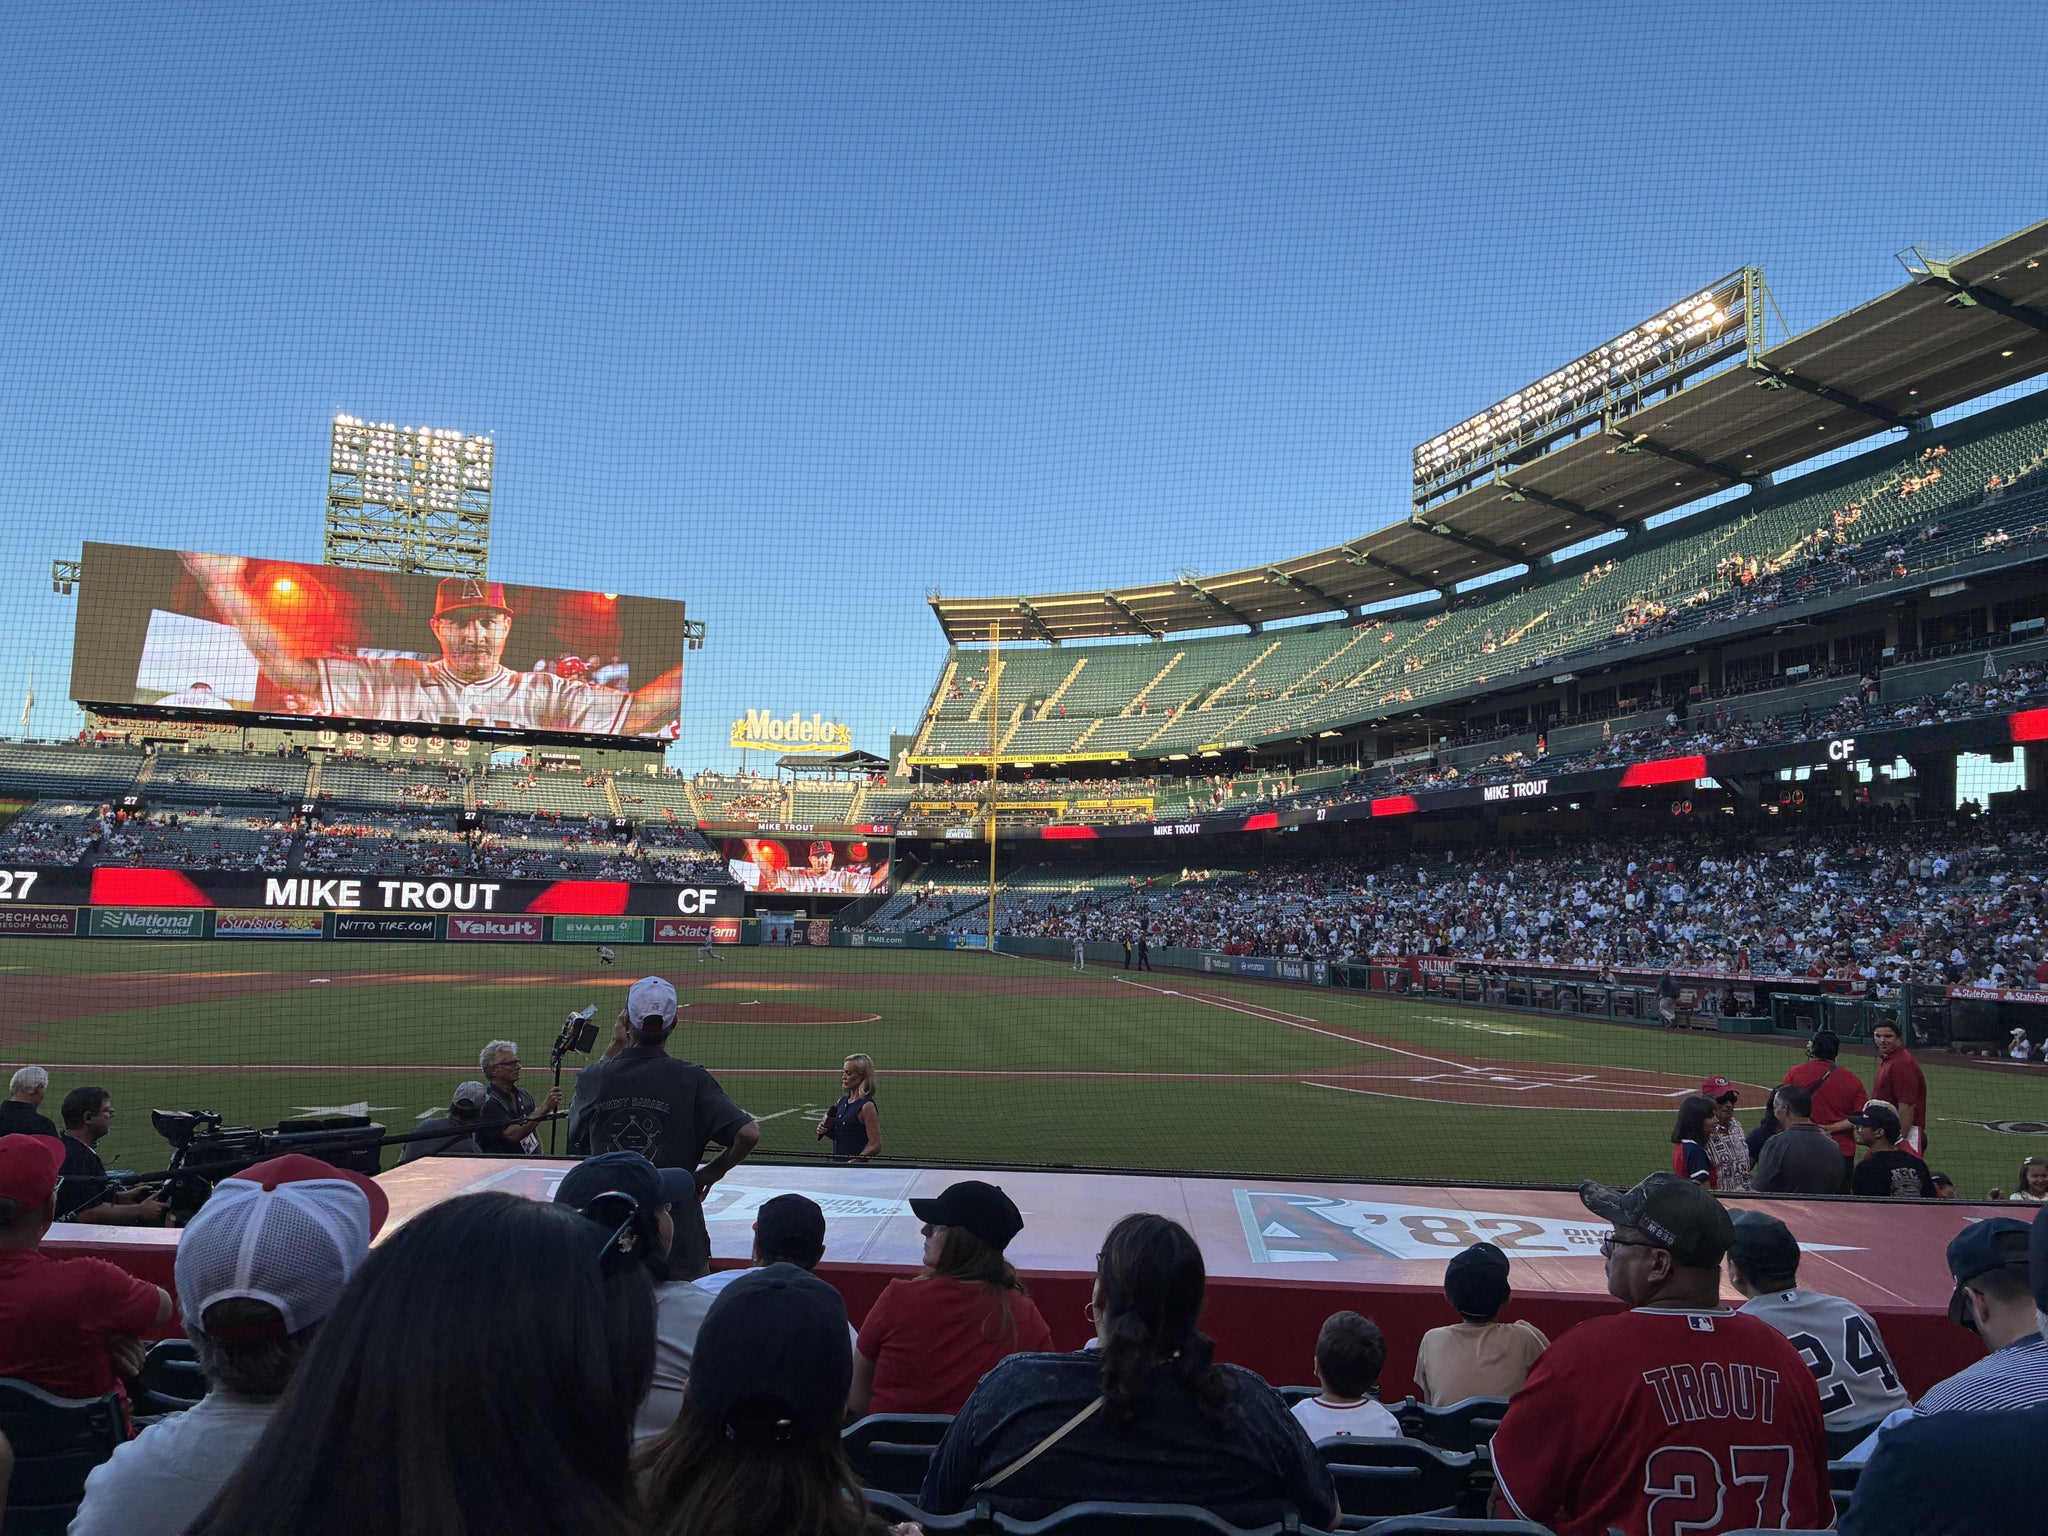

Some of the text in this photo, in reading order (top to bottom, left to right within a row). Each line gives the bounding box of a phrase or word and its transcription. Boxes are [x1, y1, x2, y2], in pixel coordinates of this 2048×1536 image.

[746, 709, 836, 742] Modelo
[323, 730, 331, 740] 11
[349, 731, 362, 742] 26
[376, 733, 389, 744] 29
[403, 735, 416, 745] 30
[429, 736, 442, 747] 42
[1828, 738, 1855, 760] CF
[1484, 779, 1548, 801] MIKE TROUT
[124, 796, 137, 805] 27
[301, 804, 314, 813] 27
[465, 811, 476, 820] 27
[1317, 808, 1326, 821] 27
[615, 818, 627, 827] 27
[785, 823, 814, 831] TROUT
[1153, 824, 1200, 835] MIKE TROUT
[0, 871, 38, 900] 27
[265, 878, 500, 910] MIKE TROUT
[677, 888, 718, 914] CF
[0, 913, 68, 923] PECHANGA
[122, 913, 194, 928] National
[221, 913, 284, 931] Surfside
[35, 922, 69, 930] CASINO
[339, 919, 376, 931] NITTO
[454, 920, 536, 935] Yakult
[867, 936, 903, 944] FMB.com
[1787, 1313, 1901, 1418] 24
[1643, 1362, 1780, 1426] TROUT
[1643, 1444, 1795, 1536] 27
